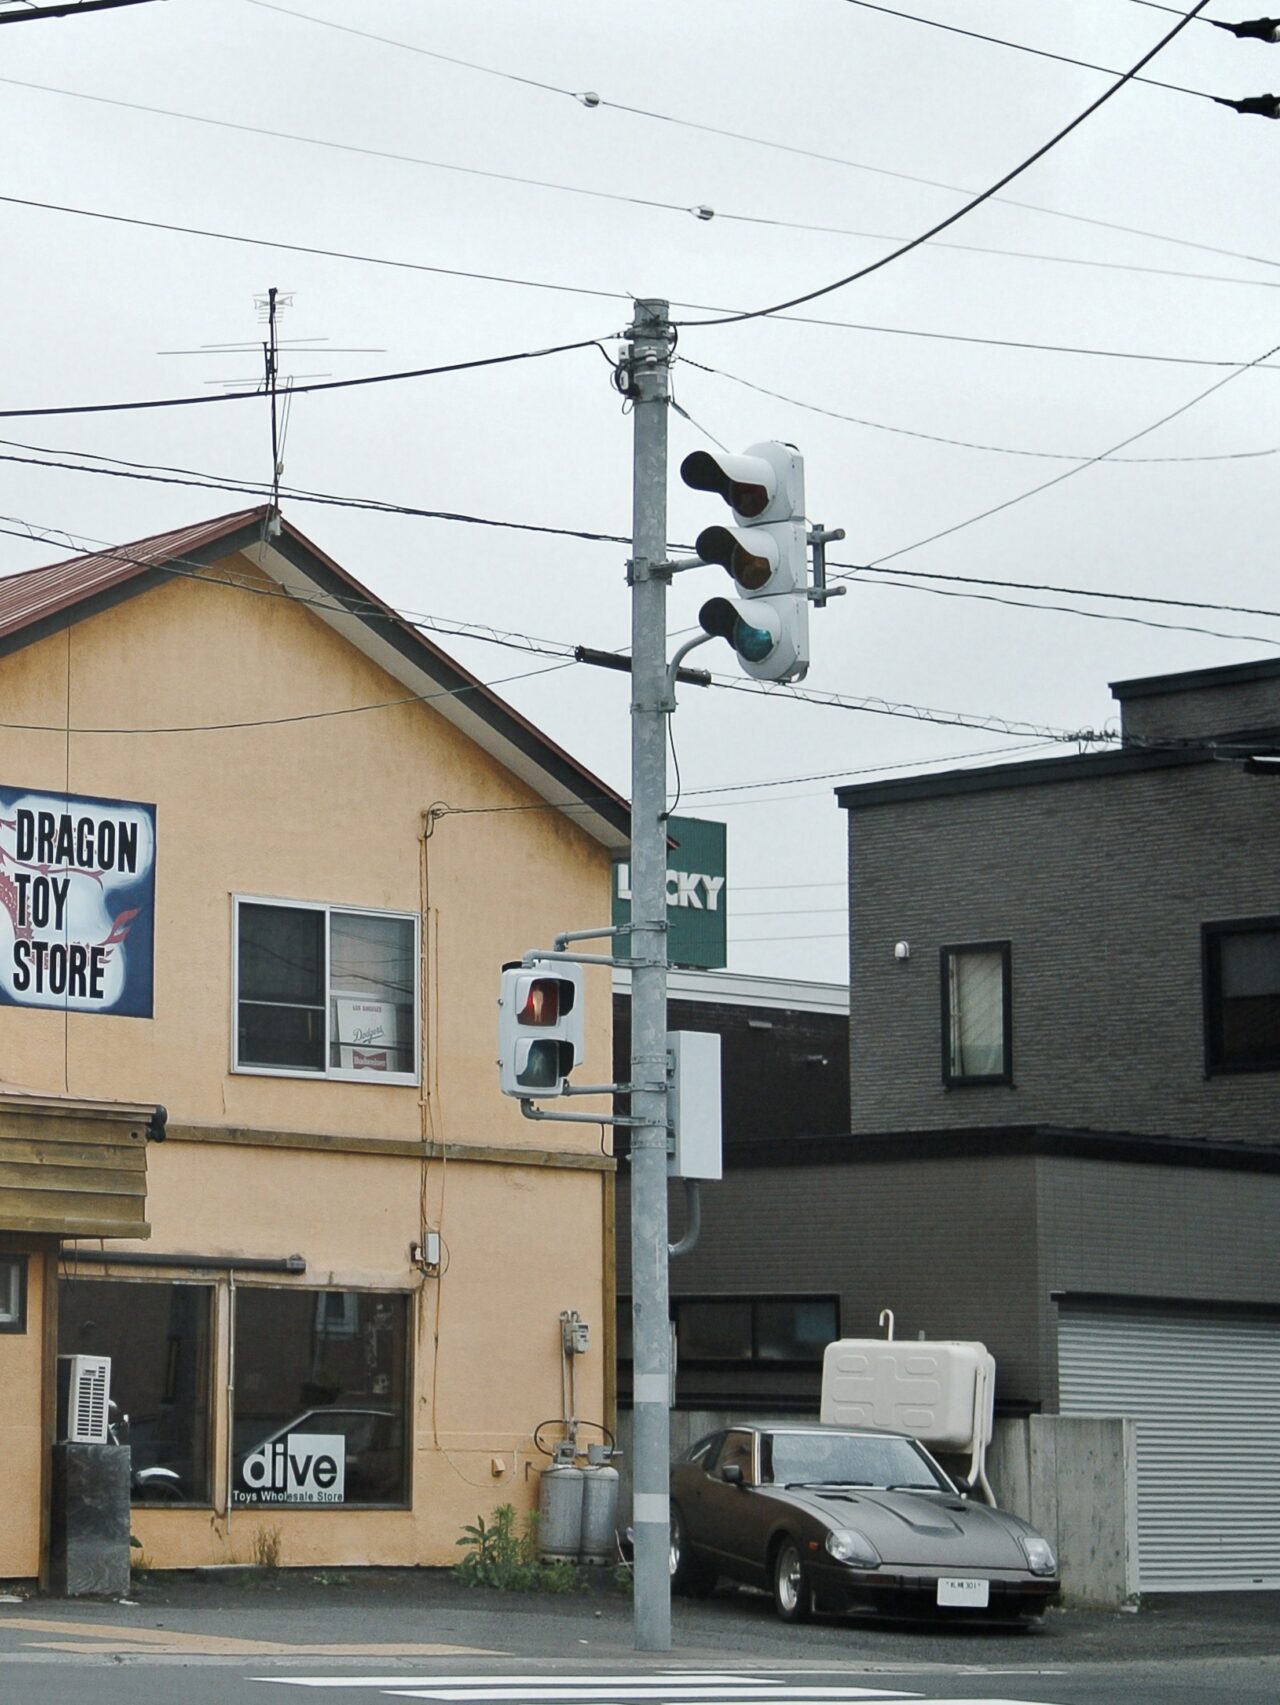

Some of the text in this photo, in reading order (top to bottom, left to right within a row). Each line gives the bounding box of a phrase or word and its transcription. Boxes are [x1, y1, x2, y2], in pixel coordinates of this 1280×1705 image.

[16, 808, 137, 874] DRAGON
[15, 873, 70, 931] TOY
[618, 864, 724, 911] LCKY
[13, 940, 105, 999] STORE
[243, 1443, 337, 1489] dive
[233, 1490, 343, 1503] Toys Wholesale Store
